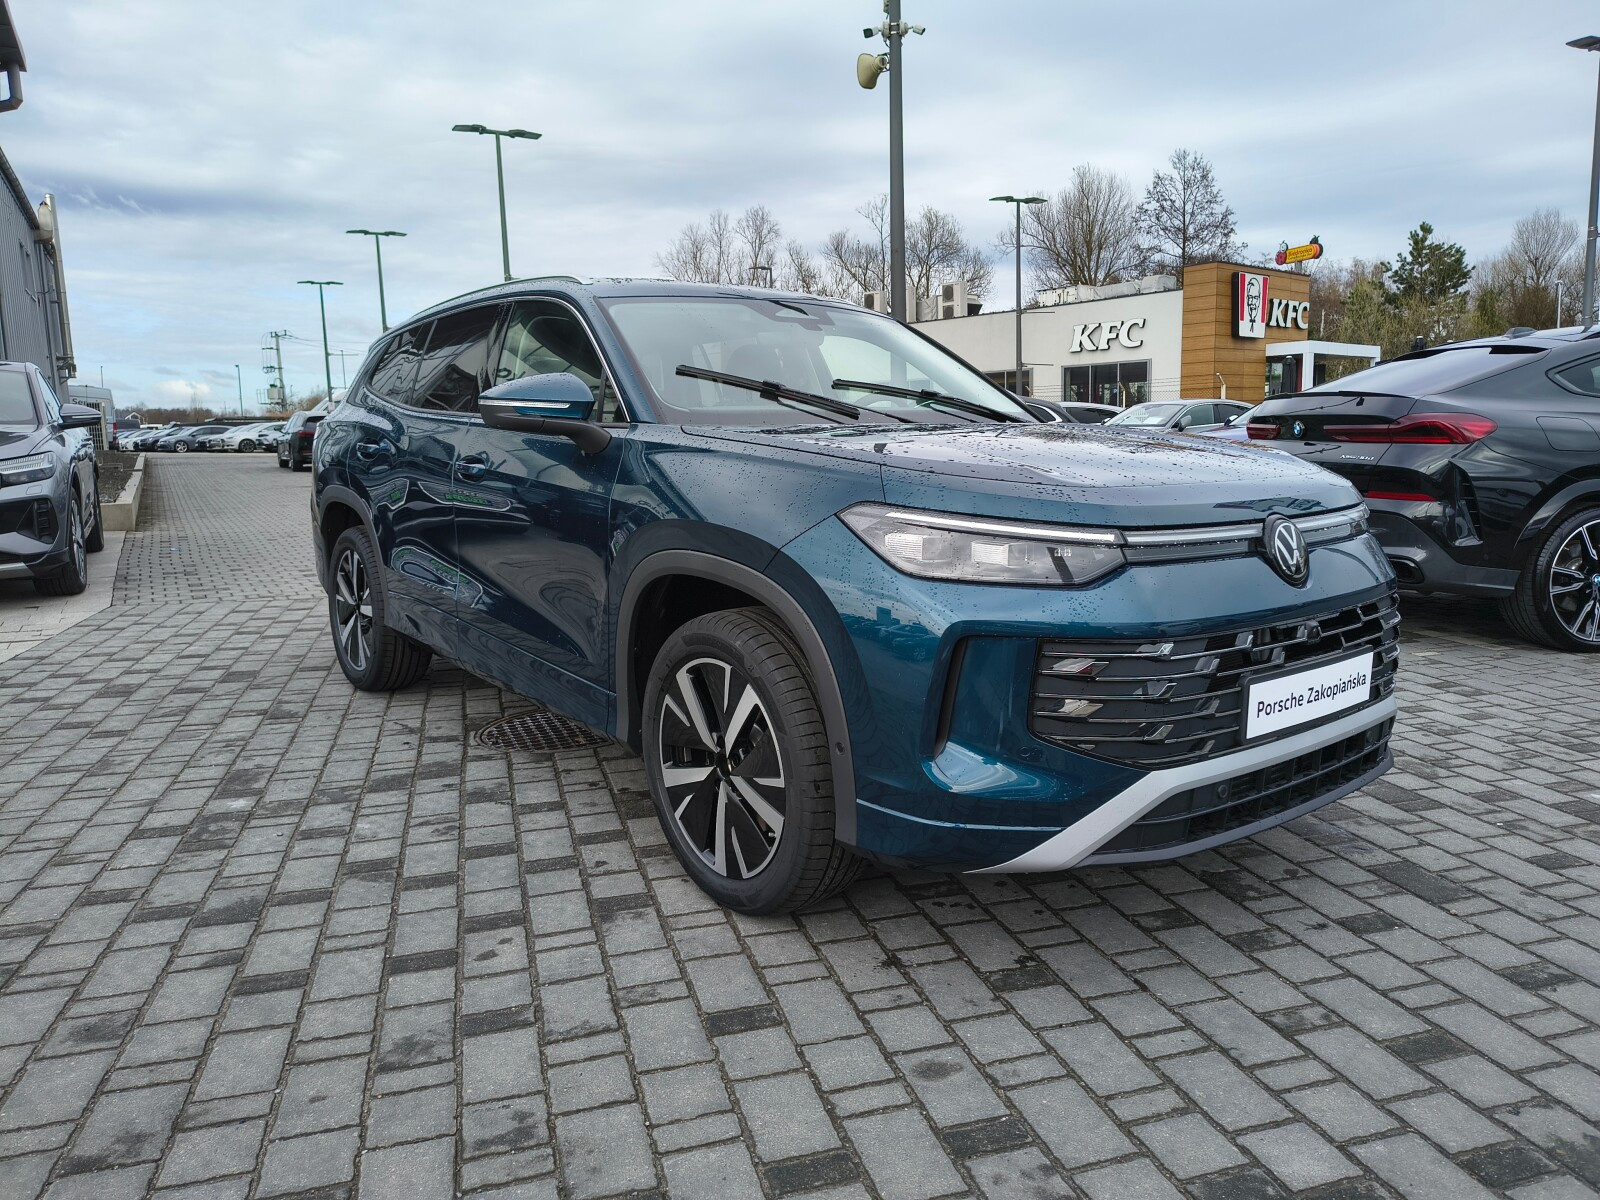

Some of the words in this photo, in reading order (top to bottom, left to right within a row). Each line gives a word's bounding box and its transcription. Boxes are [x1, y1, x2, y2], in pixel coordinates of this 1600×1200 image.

[1269, 298, 1310, 330] KFC
[1069, 318, 1146, 353] KFC
[1256, 691, 1304, 719] Porsche
[1306, 671, 1367, 704] Zakopiańska
